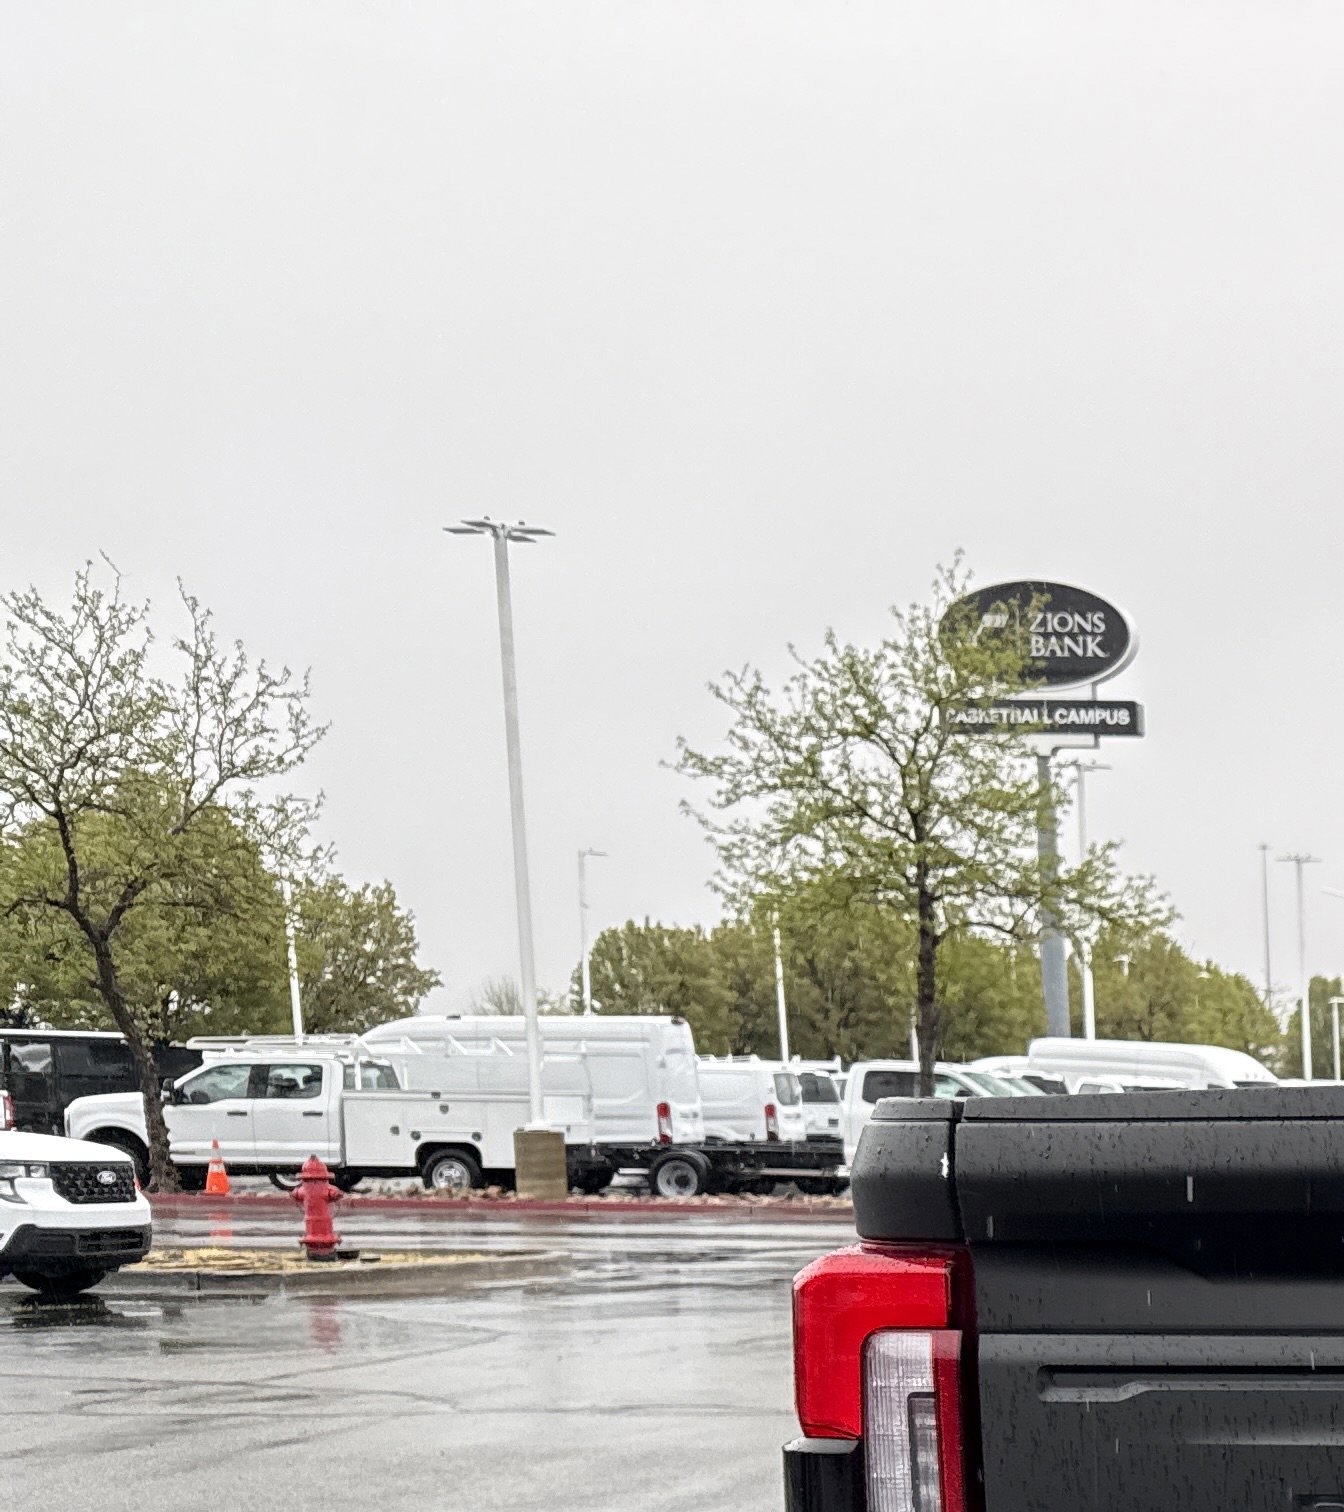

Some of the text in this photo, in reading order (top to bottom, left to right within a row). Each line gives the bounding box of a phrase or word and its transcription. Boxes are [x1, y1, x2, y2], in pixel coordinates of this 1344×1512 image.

[1030, 611, 1106, 633] ZIONS
[1030, 636, 1106, 657] BANK
[1054, 707, 1131, 725] CAMPUS
